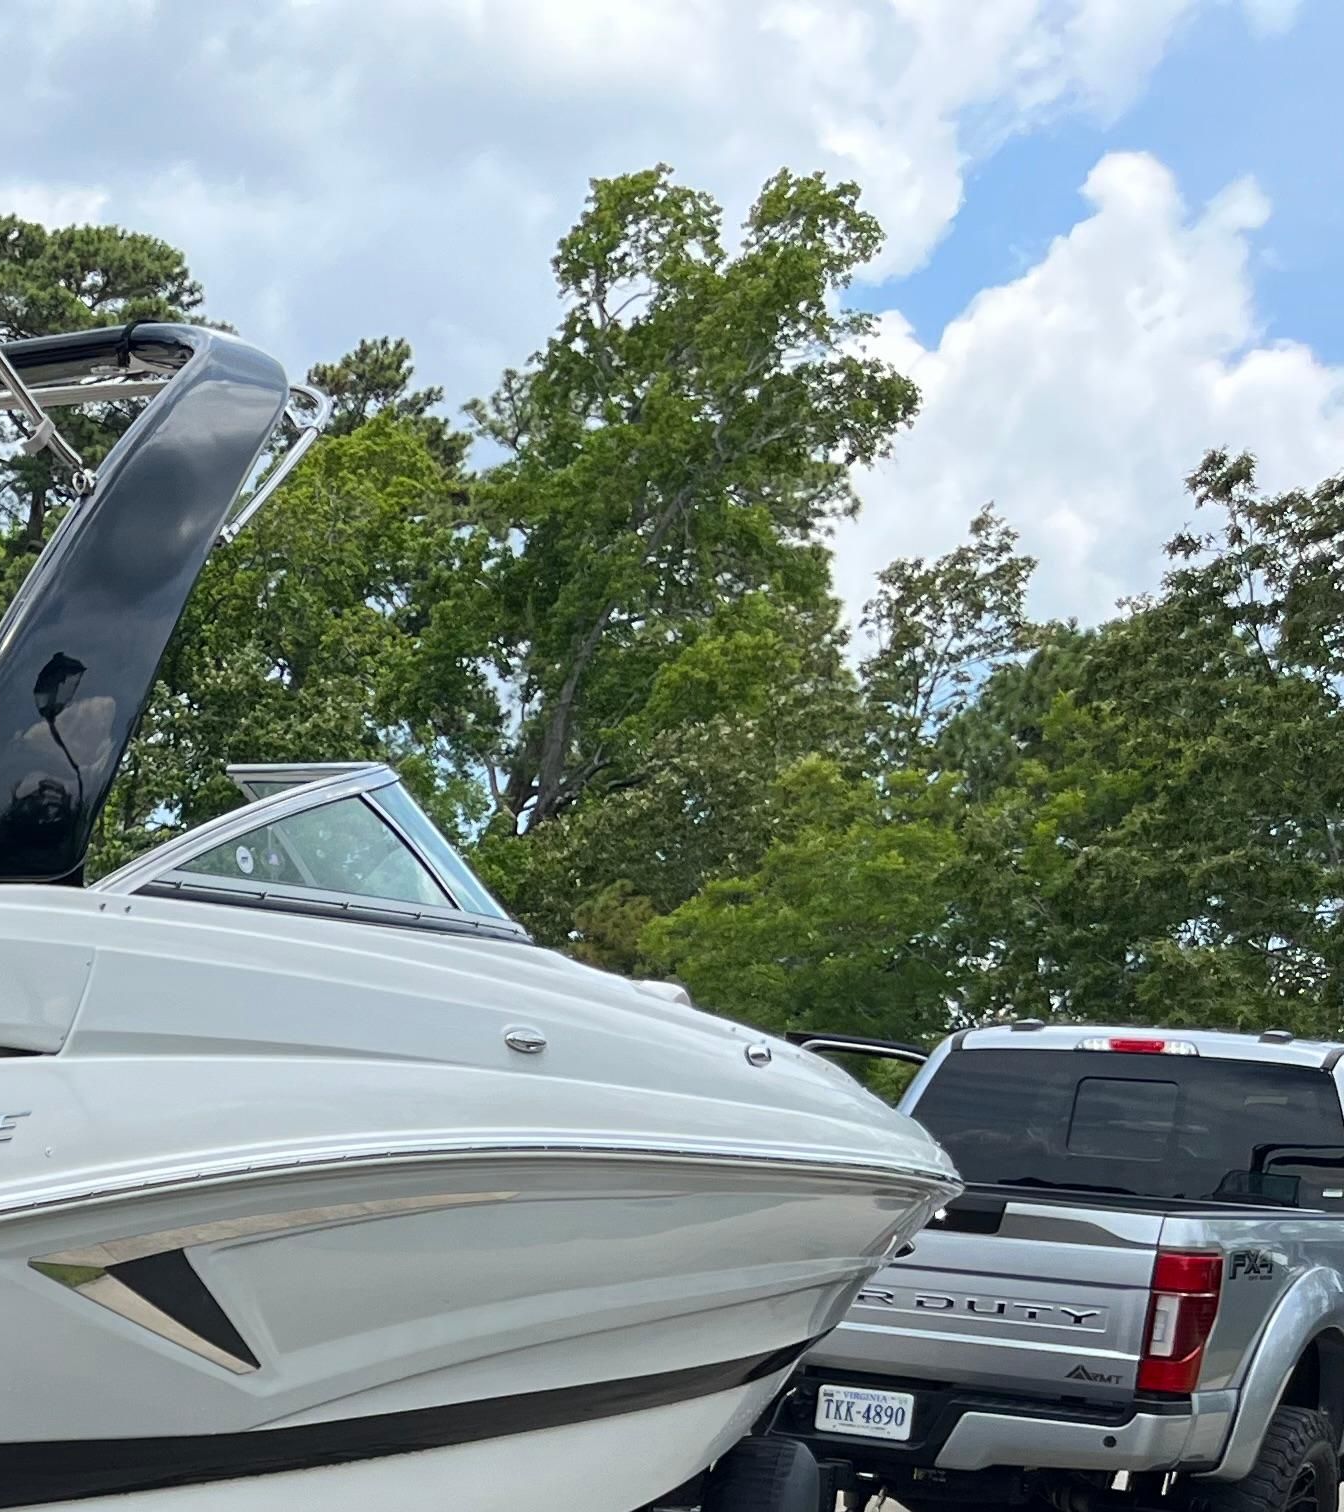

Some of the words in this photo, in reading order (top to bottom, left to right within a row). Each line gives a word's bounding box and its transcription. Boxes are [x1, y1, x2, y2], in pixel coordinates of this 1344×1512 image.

[915, 1292, 1100, 1325] DUTY
[843, 1391, 888, 1403] VIRGINIA
[823, 1398, 907, 1427] TKK-4890
